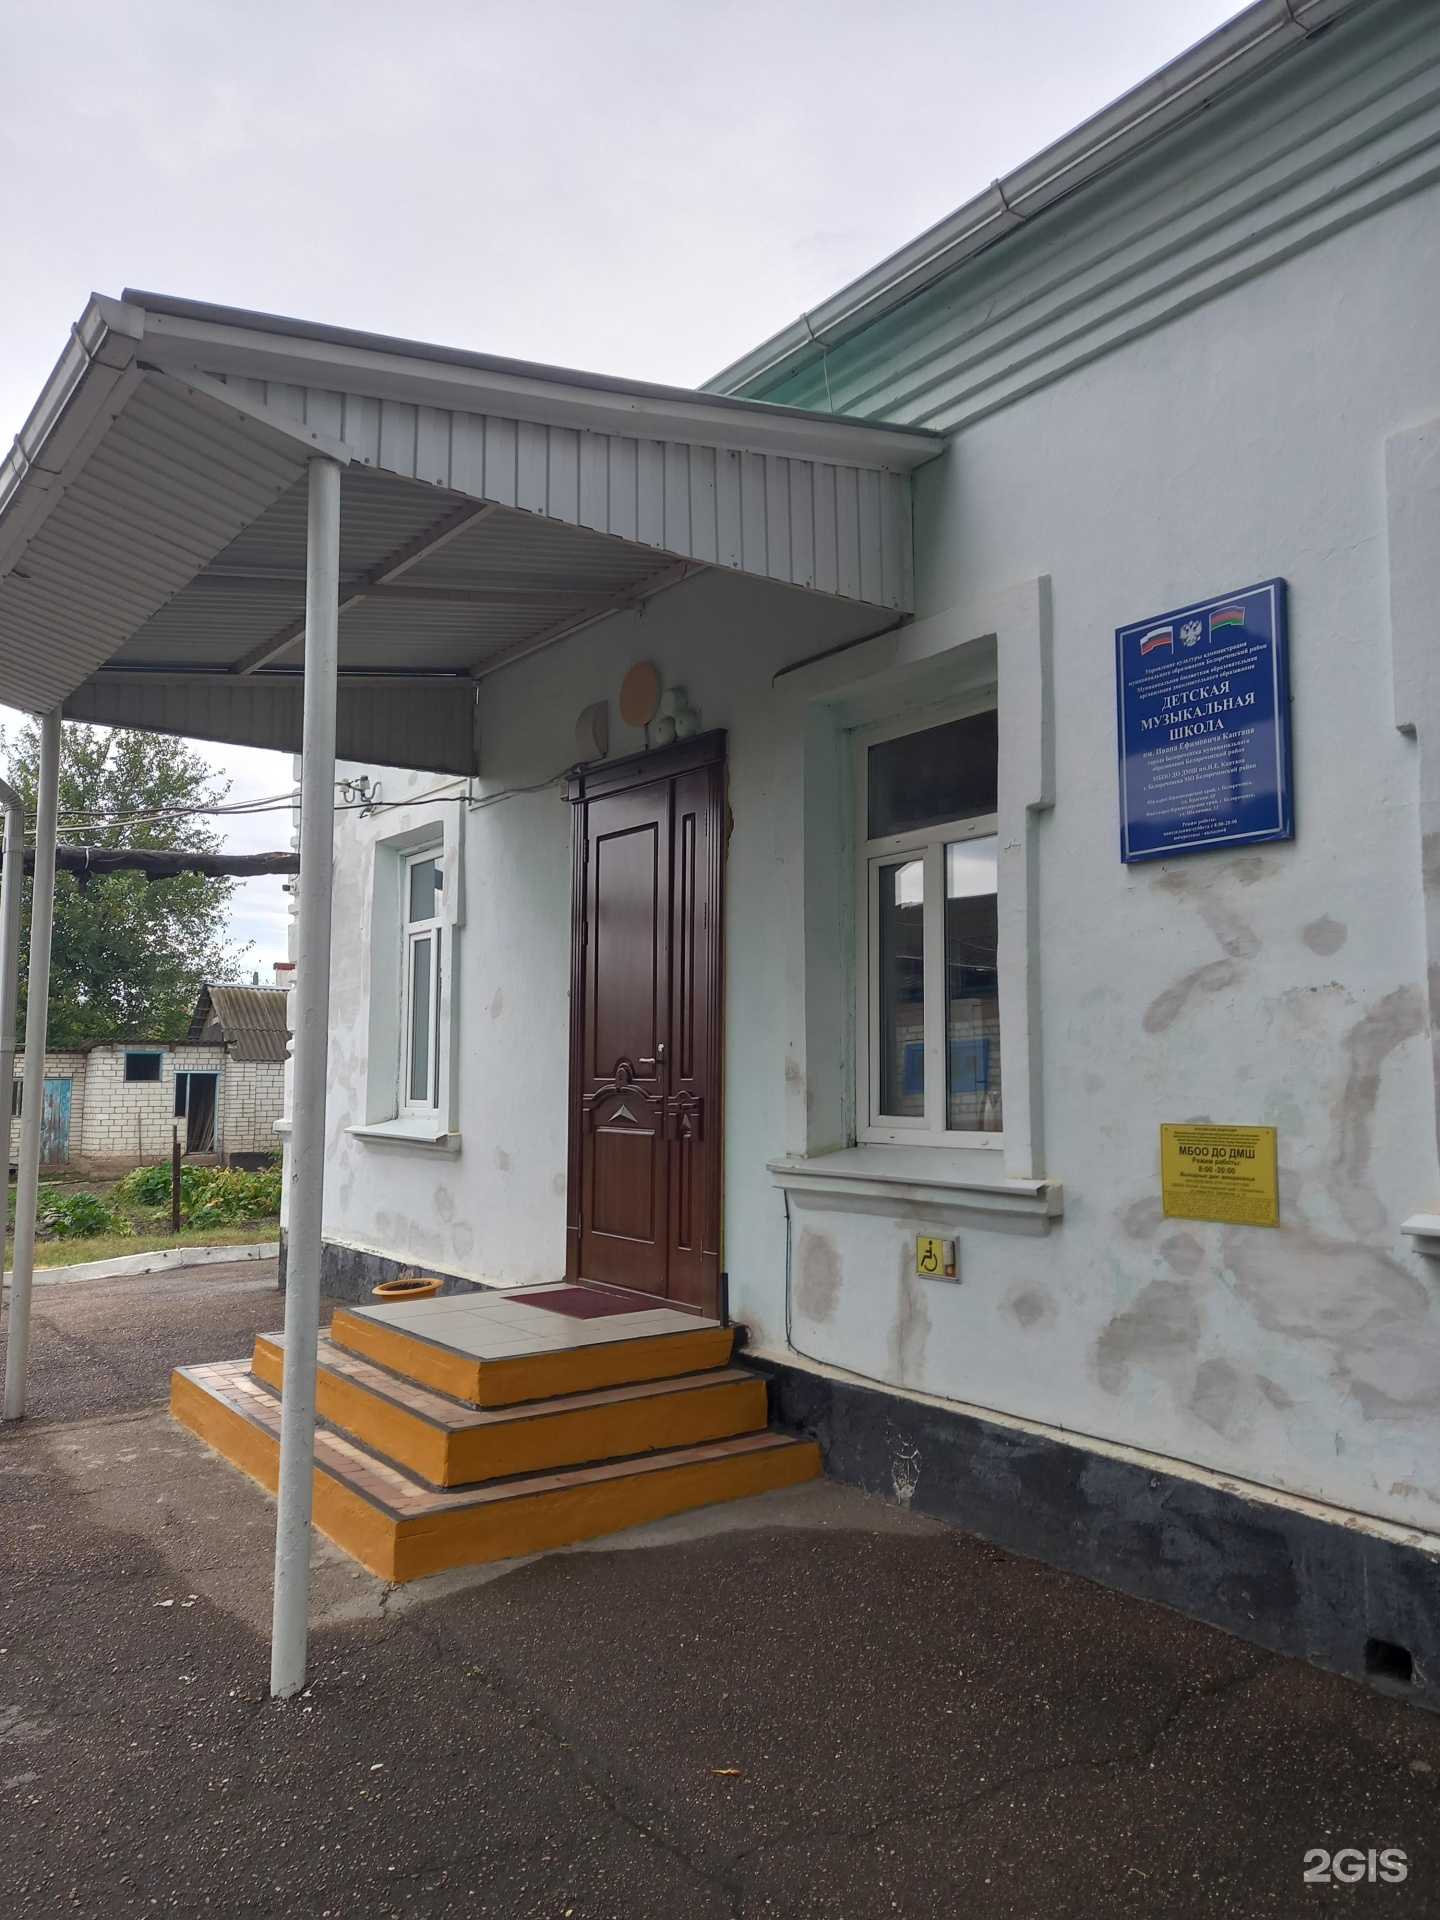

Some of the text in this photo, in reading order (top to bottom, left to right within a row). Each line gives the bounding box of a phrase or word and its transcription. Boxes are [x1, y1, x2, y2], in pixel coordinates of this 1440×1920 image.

[1162, 681, 1230, 711] ДЕТСКАЯ
[1141, 692, 1256, 731] МУЗЫКАЛЬНАЯ
[1169, 718, 1224, 741] ШКОЛА
[1178, 1146, 1256, 1160] МБОО ДО ДМШ
